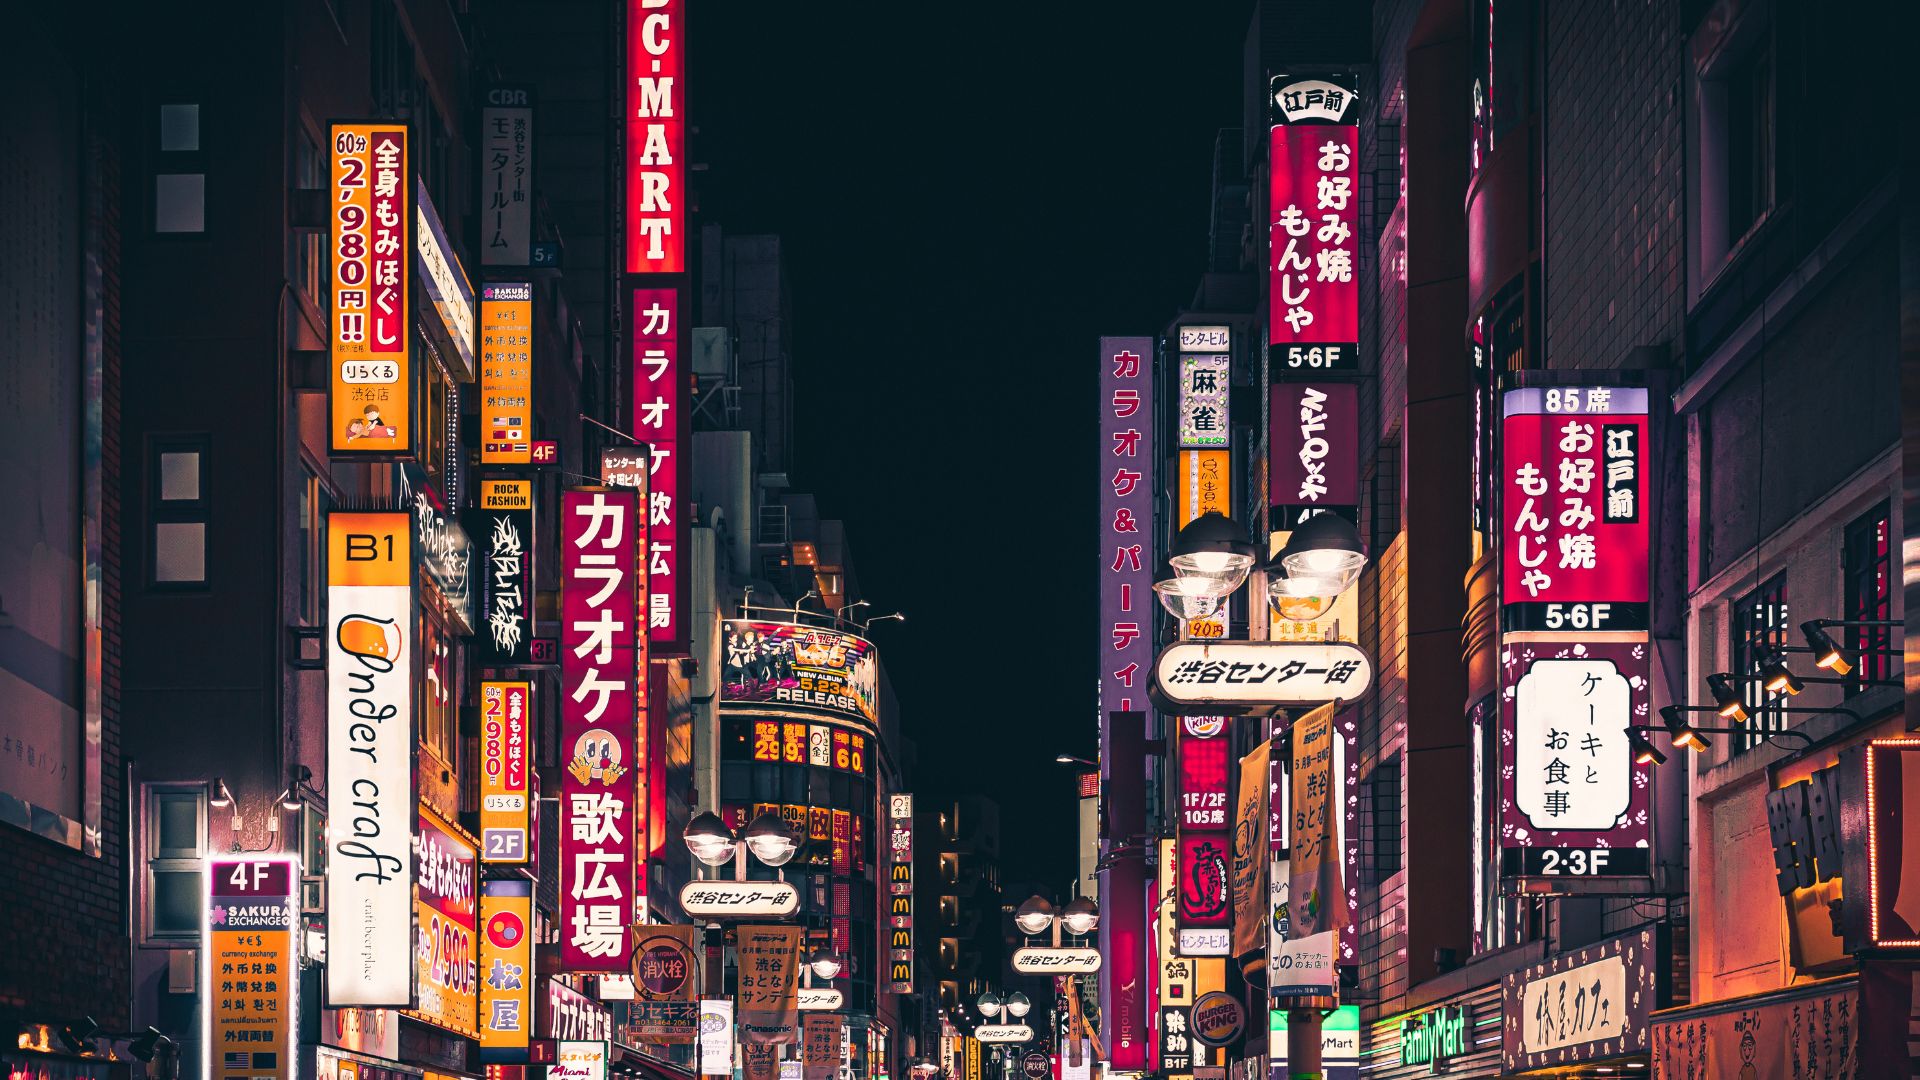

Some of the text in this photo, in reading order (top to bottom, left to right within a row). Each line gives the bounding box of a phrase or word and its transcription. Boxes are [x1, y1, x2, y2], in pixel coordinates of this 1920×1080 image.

[1284, 89, 1344, 113] 江戸前
[637, 0, 674, 259] C-MART
[336, 132, 367, 155] 60分
[1316, 140, 1352, 283] お好み焼
[374, 138, 401, 345] 全身もみほぐし
[534, 248, 554, 262] 5F
[1278, 204, 1314, 334] もんじゃ
[1181, 332, 1229, 346] センタービル
[346, 365, 394, 379] りらくる
[352, 388, 390, 401] 渋谷店
[1191, 368, 1218, 432] 麻雀
[532, 445, 555, 460] 4F
[605, 458, 645, 468] センター街
[1606, 429, 1634, 519] 江戸前
[493, 484, 520, 495] ROCK
[1558, 420, 1596, 570] お好み焼
[487, 496, 527, 506] FASHION
[1514, 462, 1552, 597] もんじゃ
[345, 534, 394, 562] B1
[535, 642, 553, 659] 3F
[797, 671, 843, 683] NEW ALBUM
[1168, 660, 1362, 685] 渋谷センター街
[800, 678, 840, 694] 5.23
[776, 688, 857, 711] RELEASE
[570, 493, 626, 958] カラオケ 歌広場
[1580, 672, 1603, 785] ケーキと
[509, 691, 523, 787] 全身もみほぐし
[336, 613, 403, 885] Under craft
[1543, 727, 1571, 818] お食事
[1182, 792, 1226, 807] 1F/2F
[783, 807, 805, 820] 30分
[1183, 811, 1225, 824] 105席
[490, 834, 520, 854] 2F
[229, 862, 270, 891] 4F
[418, 829, 474, 916] 全身もみほぐし
[686, 891, 792, 906] 渋谷センター街
[229, 906, 290, 917] SAKURA
[228, 916, 281, 926] EXCHANGE
[1181, 935, 1229, 949] センタービル
[1018, 955, 1099, 966] 渋谷センター街
[1295, 952, 1329, 960] ステッカー
[643, 959, 684, 979] 消火栓
[755, 958, 783, 972] 渋谷
[742, 975, 794, 988] おとなり
[487, 958, 524, 1032] 松屋
[741, 990, 795, 1004] サンデー
[1198, 1003, 1235, 1022] BURGER
[1536, 977, 1611, 1048] 椿屋カフェ
[745, 1024, 792, 1033] Panasonic
[1200, 1013, 1237, 1032] KING
[224, 1030, 274, 1042] 外貨両替
[1400, 1006, 1465, 1074] FamilyMart
[536, 1043, 553, 1060] 1F
[1026, 1060, 1047, 1072] 消火栓
[1164, 1058, 1189, 1070] B1F
